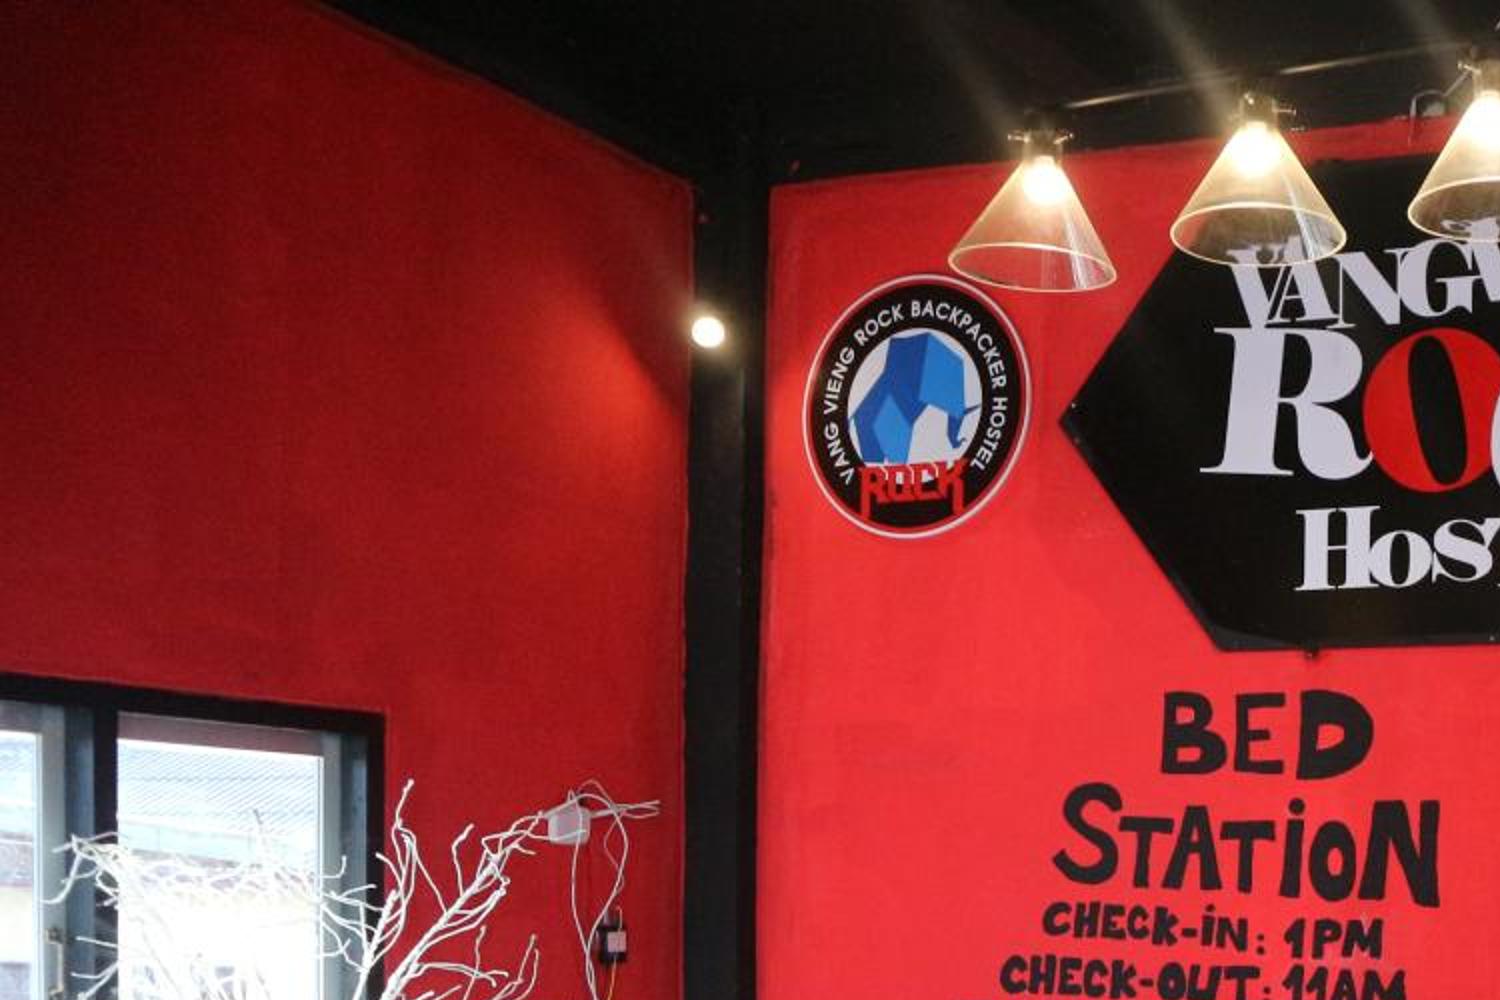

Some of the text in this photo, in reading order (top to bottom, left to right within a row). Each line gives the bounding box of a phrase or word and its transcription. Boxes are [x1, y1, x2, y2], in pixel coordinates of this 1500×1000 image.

[823, 300, 1008, 484] VANG VIENG ROCK BACKPACKER HOSTEL
[858, 458, 970, 521] ROCK
[1160, 689, 1374, 780] BED
[1284, 918, 1385, 960] 1PM
